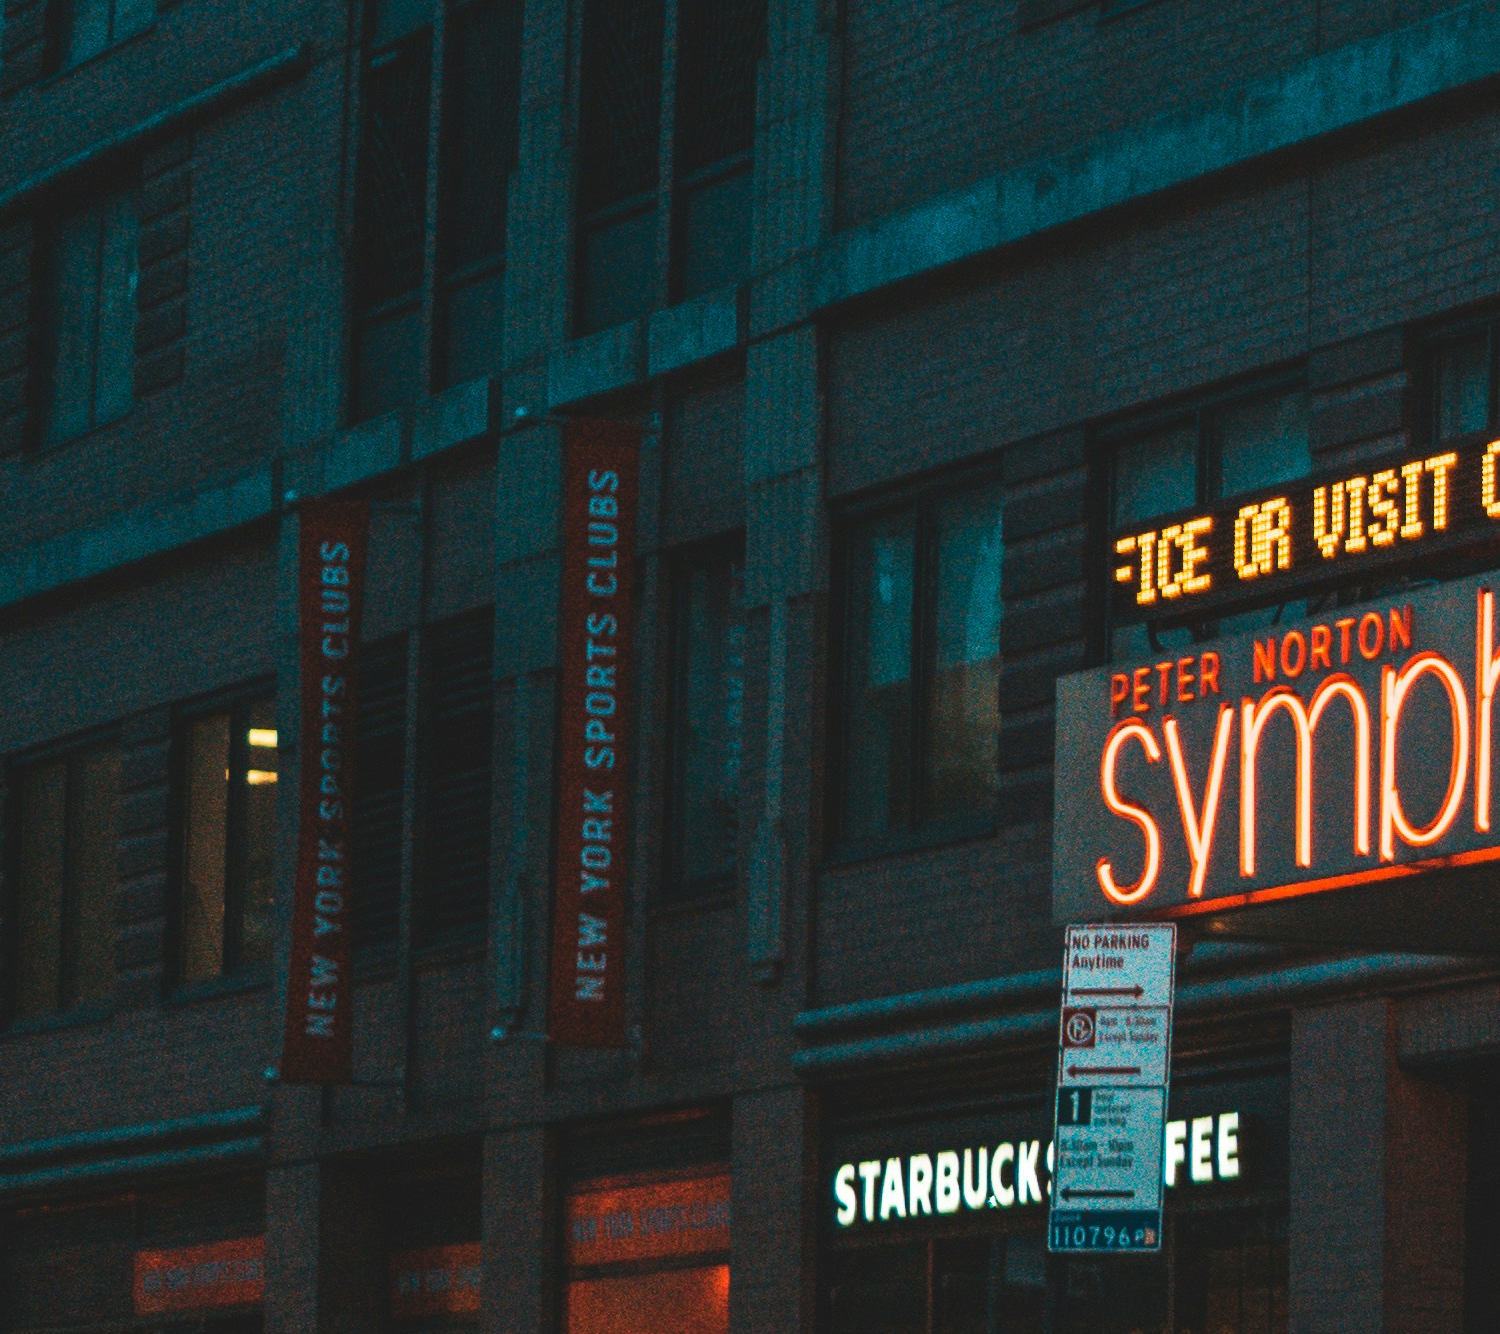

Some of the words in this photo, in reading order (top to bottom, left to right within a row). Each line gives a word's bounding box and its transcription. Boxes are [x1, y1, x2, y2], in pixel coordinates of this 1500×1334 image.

[587, 467, 620, 594] CLUBS
[1310, 450, 1458, 560] VISIT
[585, 610, 618, 769] SPORTS
[1109, 648, 1222, 717] PETER
[1252, 605, 1414, 682] NORTON
[581, 789, 614, 893] YORK
[577, 917, 607, 1003] NEW
[1072, 934, 1091, 949] NO
[1094, 933, 1150, 949] PARKING
[1072, 954, 1125, 970] Anytime
[834, 1139, 1053, 1227] STARBUCK
[1163, 1111, 1241, 1189] FEE
